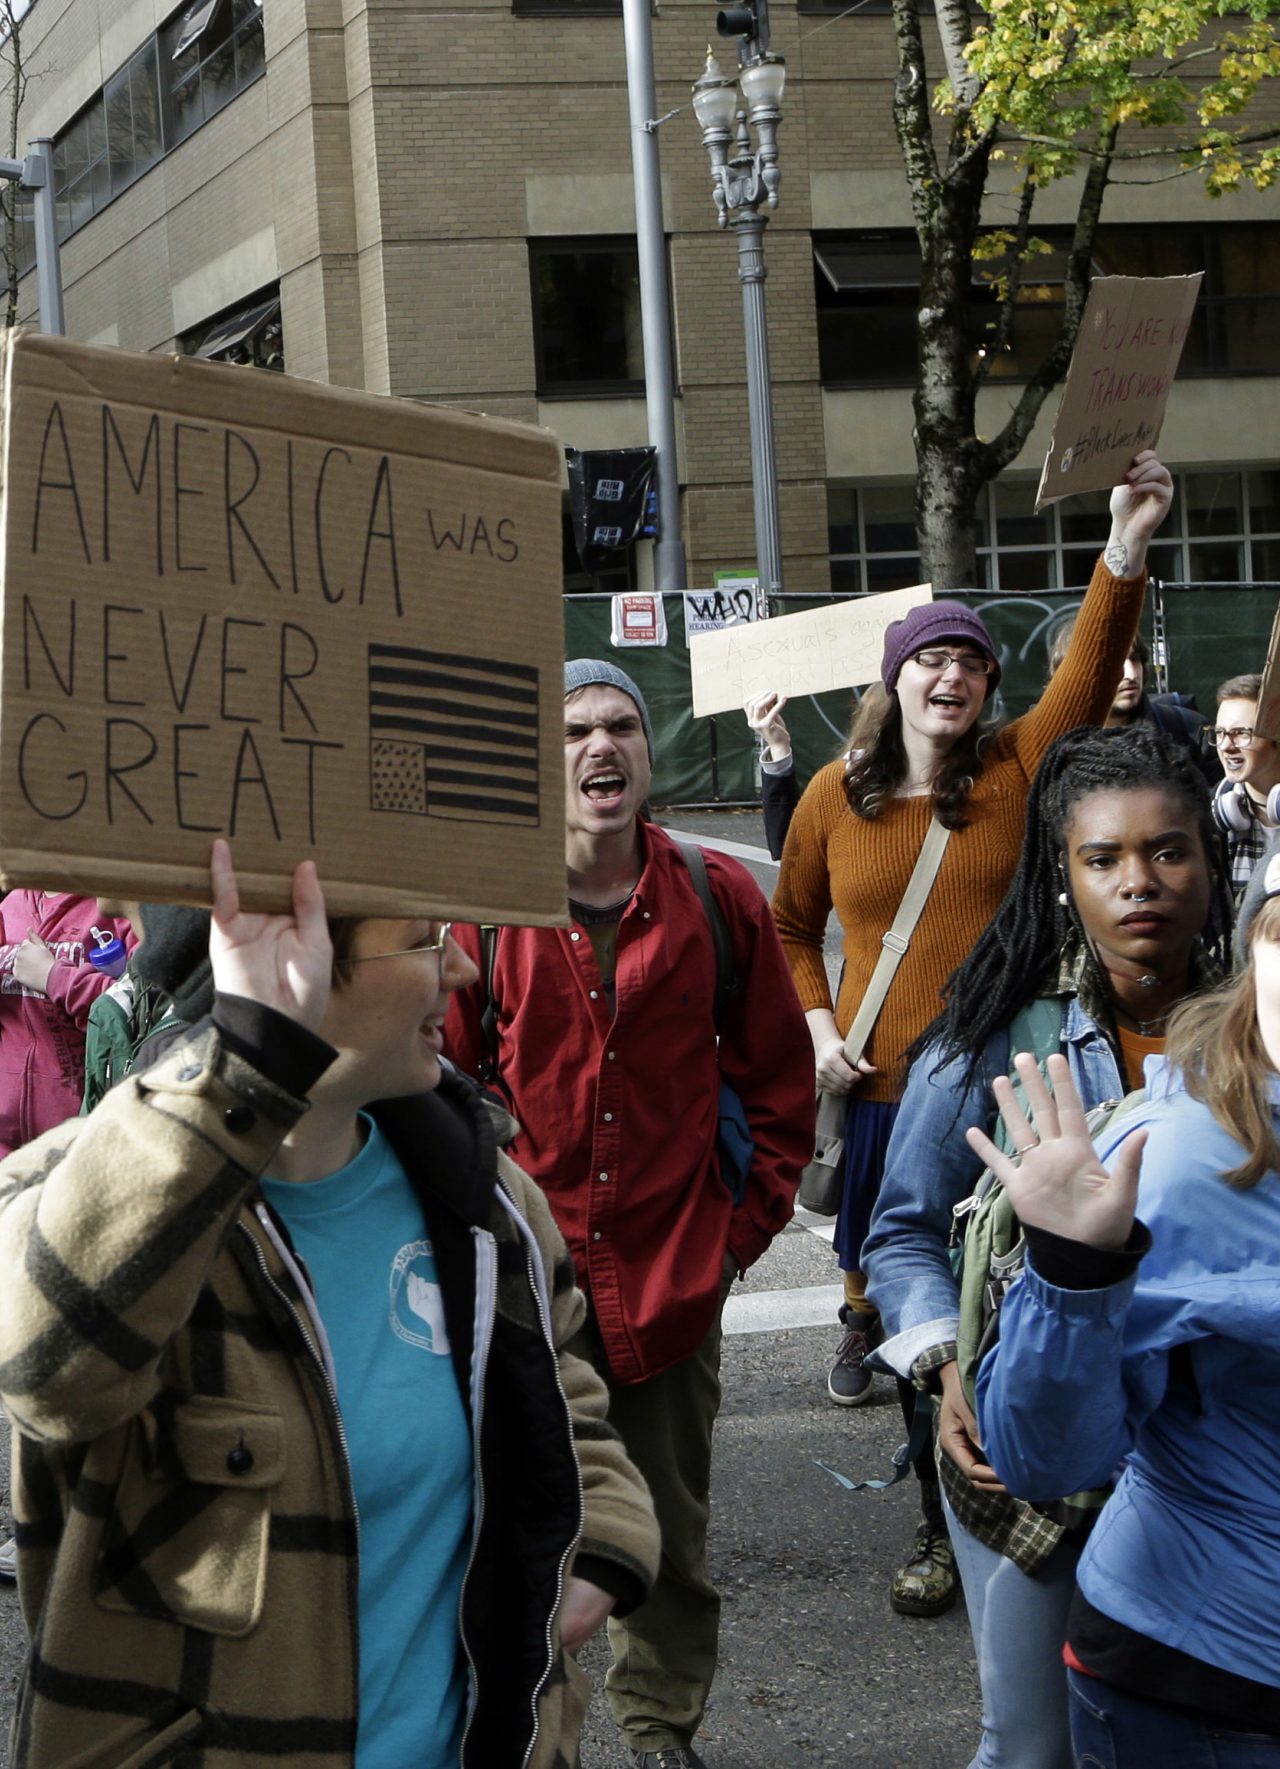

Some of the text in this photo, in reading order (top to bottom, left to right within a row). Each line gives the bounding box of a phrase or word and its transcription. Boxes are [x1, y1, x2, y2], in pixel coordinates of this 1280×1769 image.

[1084, 367, 1137, 414] TRANS
[31, 400, 519, 617] AMERICA WAS
[22, 594, 319, 734] NEVER
[689, 622, 725, 631] HEARING
[19, 713, 345, 845] GREAT
